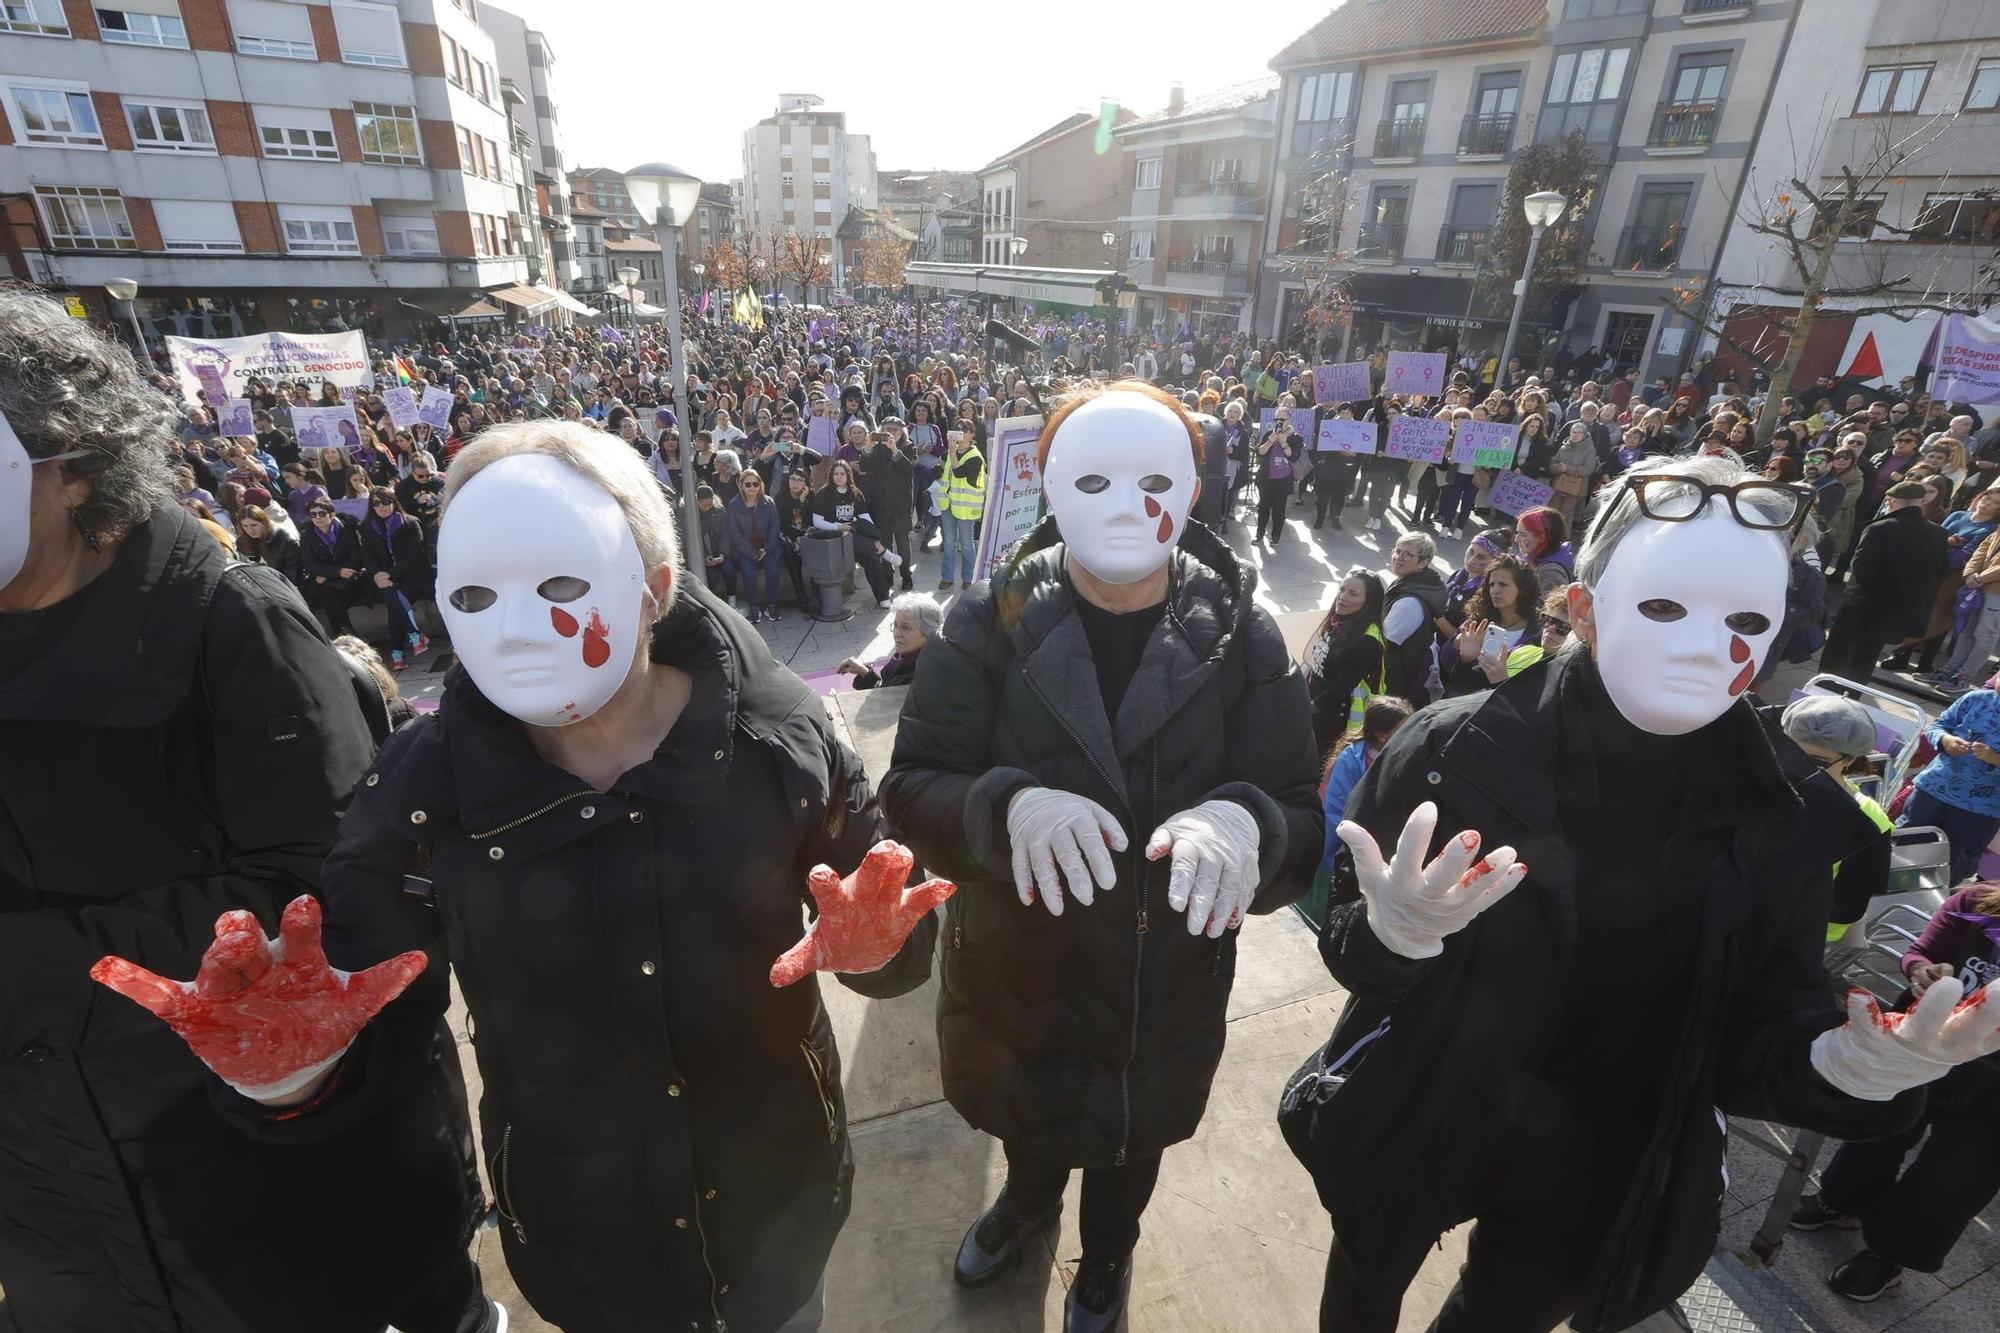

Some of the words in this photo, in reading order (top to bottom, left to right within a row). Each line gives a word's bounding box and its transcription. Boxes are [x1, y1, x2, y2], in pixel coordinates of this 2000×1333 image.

[262, 342, 329, 351] FEMINISTAS
[245, 351, 350, 366] REVOLUCIONARIAS
[233, 365, 283, 378] CONTRA
[286, 365, 300, 374] EL
[303, 361, 365, 373] GENOCIDIO
[1316, 364, 1363, 380] QUIERO
[1398, 418, 1430, 430] SOMOS
[1434, 422, 1444, 431] EL
[1464, 422, 1484, 432] SIN
[1488, 424, 1512, 436] LUCHA
[1402, 428, 1428, 438] GRITO
[1402, 436, 1416, 445] LAS
[1482, 435, 1499, 448] NO
[1005, 507, 1022, 520] por
[1023, 504, 1036, 514] su
[1014, 521, 1032, 532] una
